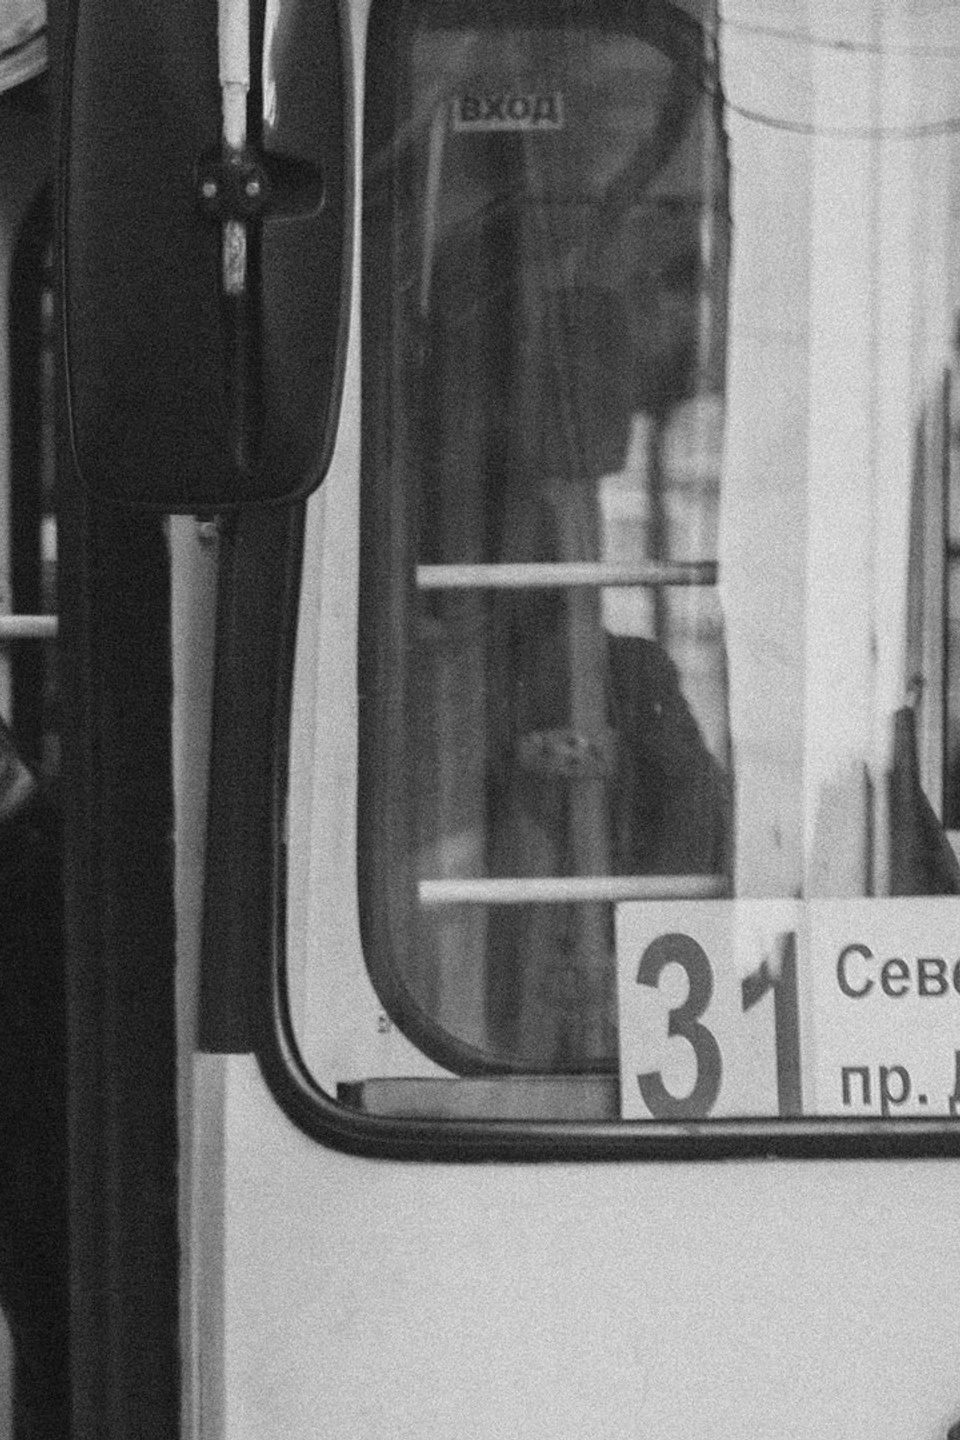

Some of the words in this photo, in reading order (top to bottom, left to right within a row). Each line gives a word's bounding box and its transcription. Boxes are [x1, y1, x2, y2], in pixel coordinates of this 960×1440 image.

[837, 943, 960, 997] Сев
[637, 931, 803, 1117] 31
[842, 1065, 928, 1116] пр.
